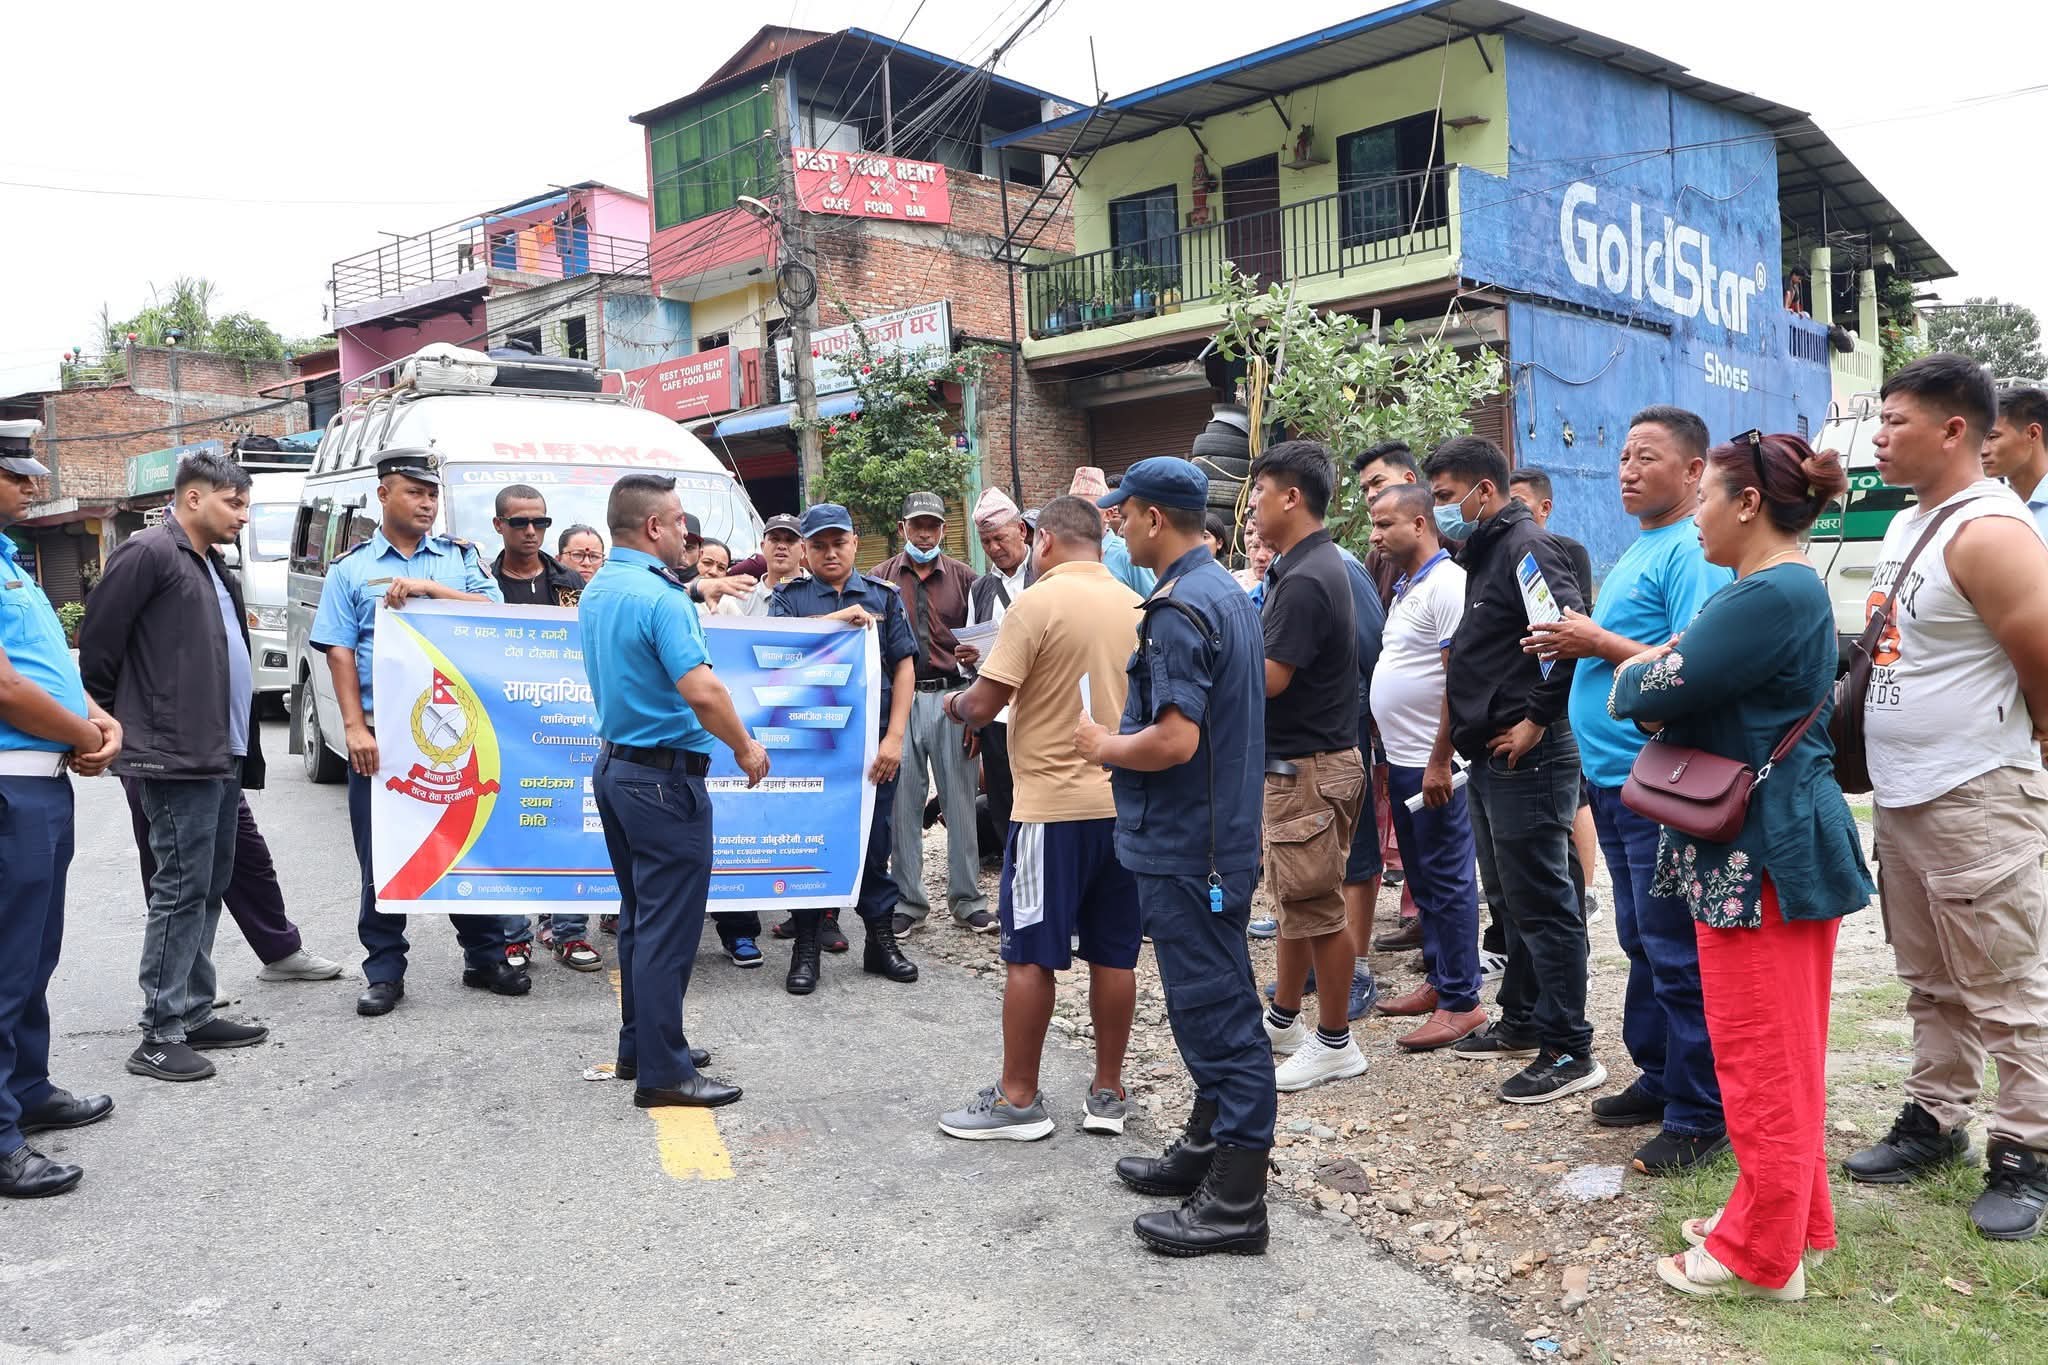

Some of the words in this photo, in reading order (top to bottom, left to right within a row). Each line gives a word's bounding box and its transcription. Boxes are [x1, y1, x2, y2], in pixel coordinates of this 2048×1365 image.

[795, 150, 839, 173] REST
[846, 155, 890, 178] TOUR
[895, 161, 937, 184] RENT
[822, 198, 850, 211] CAFE
[864, 201, 894, 215] FOOD
[905, 204, 926, 217] BAR
[909, 312, 937, 334] घर
[659, 370, 679, 382] REST
[680, 365, 702, 377] TOUR
[703, 358, 725, 371] RENT
[662, 379, 681, 392] CAFE
[683, 375, 704, 387] FOOD
[705, 370, 722, 381] BAR
[462, 471, 559, 484] CASPER
[1847, 475, 1888, 489] TO
[532, 731, 603, 750] Community
[519, 797, 554, 808] स्थान
